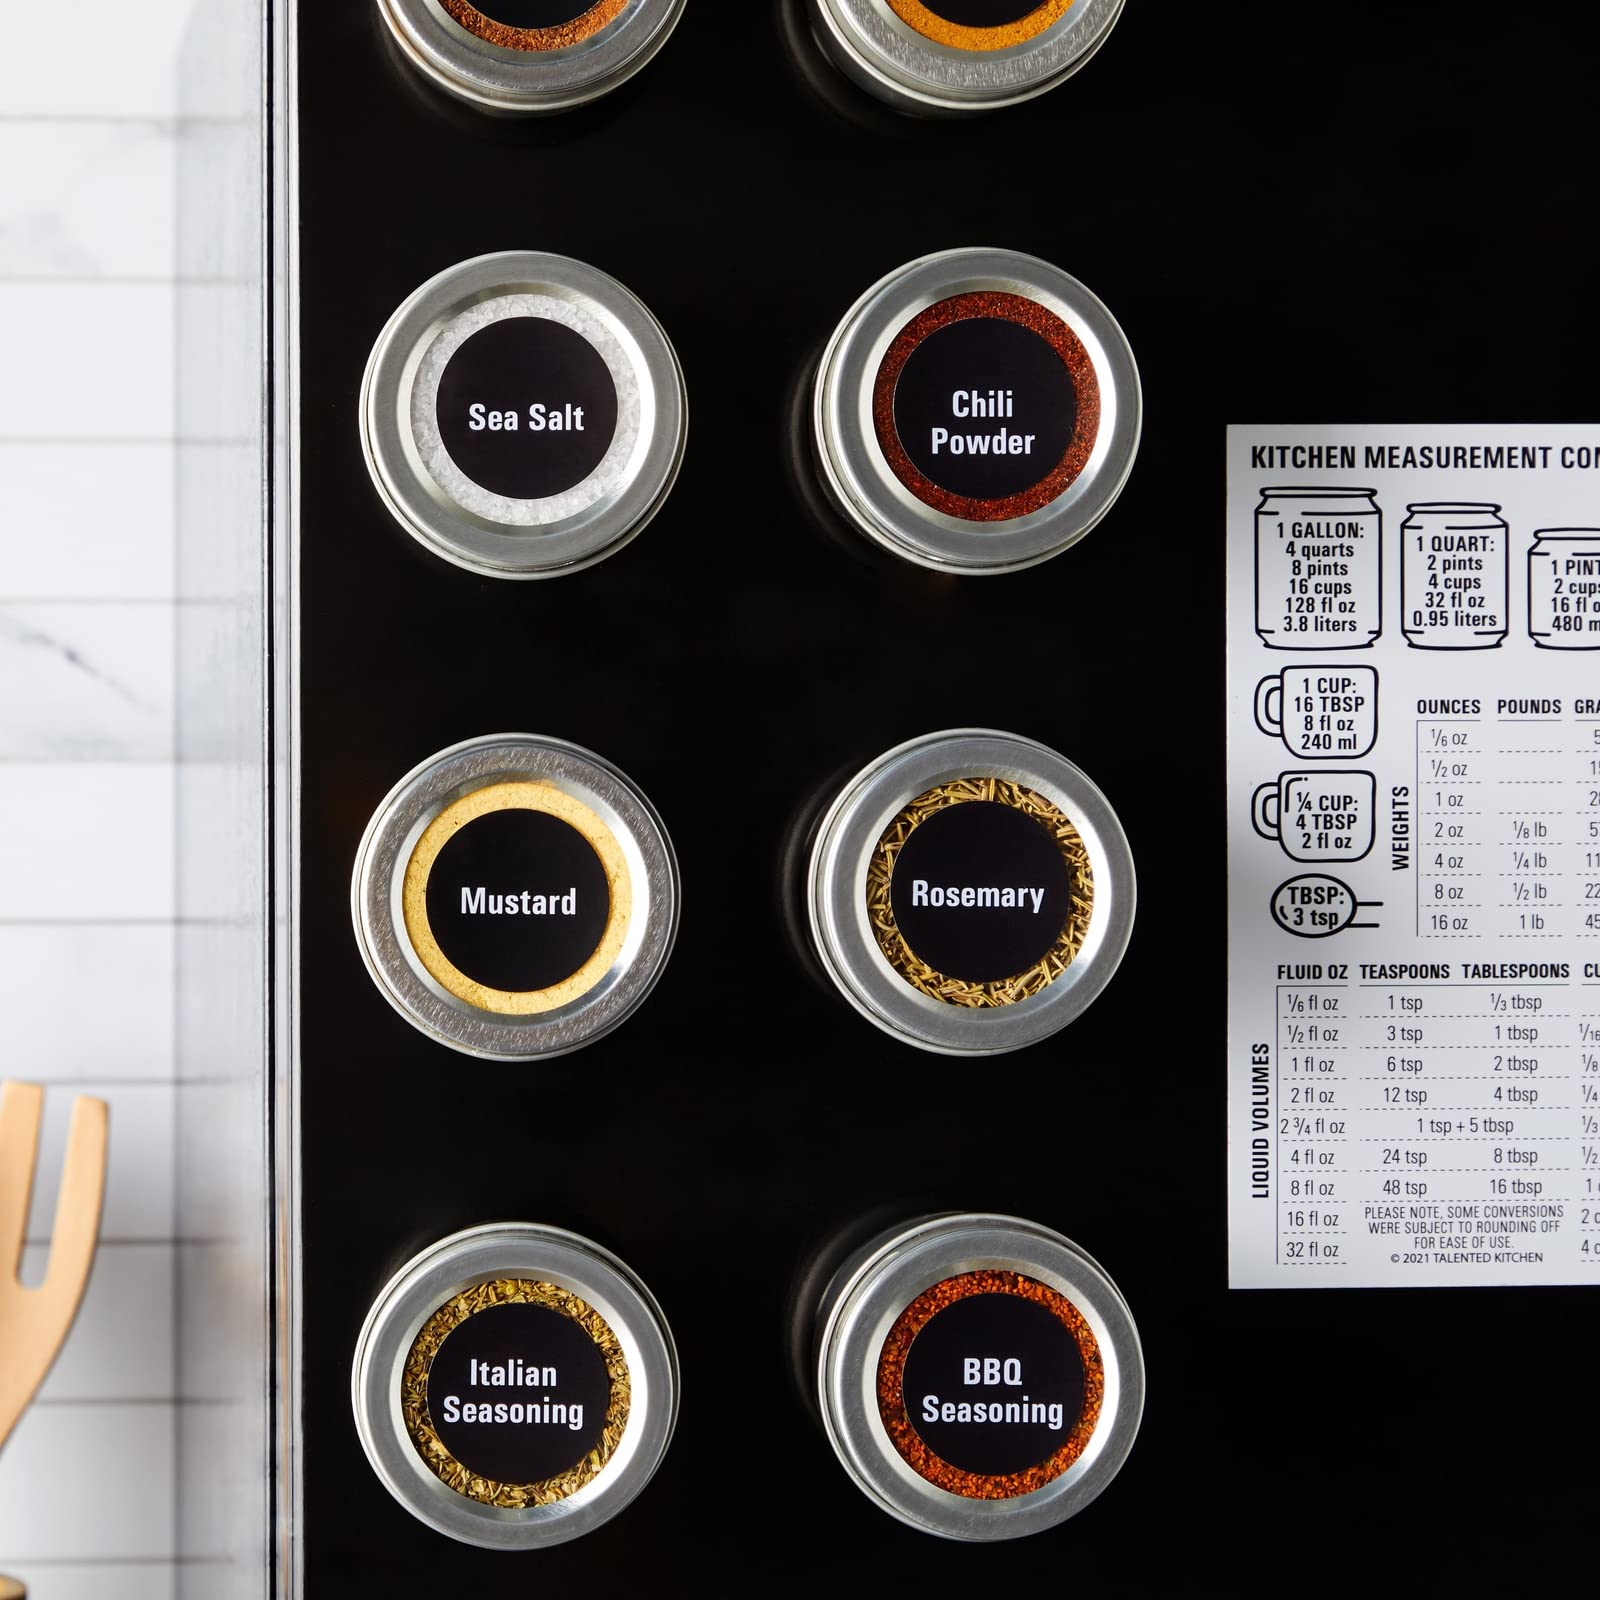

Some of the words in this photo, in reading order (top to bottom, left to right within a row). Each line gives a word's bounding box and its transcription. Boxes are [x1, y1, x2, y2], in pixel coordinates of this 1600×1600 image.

[952, 390, 1013, 418] Chili
[468, 403, 519, 431] Sea
[528, 403, 585, 431] Salt
[931, 427, 1036, 455] Powder
[1251, 445, 1356, 469] KITCHEN
[1364, 445, 1553, 469] MEASUREMENT
[1277, 522, 1284, 539] 1
[1291, 521, 1364, 539] GALLON:
[1285, 540, 1297, 557] 4
[1301, 542, 1354, 561] quarts
[1416, 535, 1423, 552] 1
[1431, 535, 1494, 552] QUART:
[1292, 559, 1302, 576] 8
[1307, 559, 1348, 580] pints
[1427, 554, 1437, 571] 2
[1442, 554, 1483, 575] pints
[1551, 559, 1558, 576] 1
[1289, 578, 1309, 595] 16
[1314, 582, 1352, 599] cups
[1428, 573, 1439, 589] 4
[1444, 577, 1482, 593] cups
[1554, 578, 1564, 594] 2
[1569, 582, 1600, 598] cup
[1285, 596, 1315, 614] 128
[1320, 596, 1333, 613] fl
[1338, 601, 1356, 614] oz
[1425, 591, 1445, 608] 32
[1450, 591, 1462, 608] fl
[1468, 596, 1485, 608] oz
[1551, 596, 1570, 613] 16
[1575, 596, 1587, 613] fl
[1283, 615, 1308, 632] 3.8
[1314, 615, 1357, 632] liters
[1413, 610, 1449, 627] 0.95
[1454, 610, 1497, 627] liters
[1552, 615, 1583, 632] 480
[1303, 677, 1309, 694] 1
[1317, 677, 1356, 694] CUP:
[1294, 696, 1313, 713] 16
[1319, 696, 1365, 713] TBSP
[1417, 699, 1481, 714] OUNCES
[1497, 699, 1562, 714] POUNDS
[1304, 714, 1314, 732] 8
[1319, 714, 1331, 731] fl
[1336, 719, 1354, 731] oz
[1301, 733, 1332, 750] 240
[1338, 733, 1357, 750] ml
[1318, 795, 1358, 812] CUP:
[1435, 791, 1441, 807] 1
[1448, 794, 1464, 807] oz
[1295, 813, 1307, 831] 4
[1311, 813, 1357, 831] TBSP
[1391, 786, 1409, 871] WEIGHTS
[1434, 821, 1444, 838] 2
[1448, 825, 1464, 838] oz
[1302, 832, 1312, 849] 2
[1316, 832, 1329, 849] fl
[1334, 836, 1352, 849] oz
[1434, 853, 1444, 868] 4
[1448, 856, 1464, 869] oz
[912, 879, 1045, 914] Rosemary
[1287, 885, 1345, 905] TBSP:
[1434, 883, 1444, 900] 8
[1448, 887, 1464, 900] oz
[1534, 883, 1547, 899] lb
[461, 886, 576, 915] Mustard
[1293, 907, 1304, 926] 3
[1309, 909, 1339, 930] tsp
[1431, 914, 1448, 930] 16
[1452, 918, 1468, 930] oz
[1519, 914, 1525, 930] 1
[1531, 913, 1545, 930] lb
[1277, 964, 1323, 980] FLUID
[1327, 964, 1349, 980] OZ
[1359, 963, 1450, 980] TEASPOONS
[1461, 963, 1570, 979] TABLESPOONS
[1308, 994, 1318, 1011] fl
[1322, 998, 1339, 1011] oz
[1388, 994, 1394, 1010] 1
[1400, 996, 1423, 1014] tsp
[1511, 993, 1542, 1013] tbsp
[1387, 1025, 1396, 1041] 3
[1400, 1027, 1423, 1045] tsp
[1495, 1025, 1501, 1041] 1
[1507, 1024, 1538, 1044] tbsp
[1292, 1056, 1298, 1073] 1
[1304, 1056, 1314, 1073] fl
[1318, 1060, 1335, 1073] oz
[1387, 1055, 1396, 1072] 6
[1400, 1057, 1423, 1076] tsp
[1493, 1055, 1503, 1071] 2
[1507, 1055, 1538, 1075] tbsp
[1251, 1043, 1270, 1132] VOLUMES
[1291, 1087, 1300, 1104] 2
[1304, 1087, 1314, 1103] fl
[1319, 1091, 1335, 1104] oz
[1383, 1086, 1401, 1103] 12
[1405, 1088, 1427, 1106] tsp
[1493, 1086, 1503, 1101] 4
[1506, 1085, 1538, 1105] tbsp
[1417, 1117, 1423, 1133] 1
[1429, 1119, 1452, 1137] tsp
[1470, 1117, 1479, 1133] 5
[1482, 1116, 1514, 1136] tbsp
[1290, 1149, 1300, 1165] 4
[1304, 1148, 1314, 1165] fl
[1319, 1152, 1335, 1165] oz
[1383, 1148, 1401, 1165] 24
[1405, 1150, 1428, 1168] tsp
[1493, 1147, 1503, 1164] 8
[1506, 1147, 1538, 1167] tbsp
[1251, 1138, 1269, 1199] LIQUID
[1290, 1180, 1300, 1196] 8
[1304, 1179, 1314, 1196] fl
[1319, 1183, 1335, 1196] oz
[1382, 1179, 1401, 1195] 48
[1404, 1181, 1427, 1199] tsp
[1490, 1178, 1507, 1195] 16
[1511, 1178, 1543, 1198] tbsp
[1287, 1210, 1304, 1227] 16
[1308, 1210, 1318, 1226] fl
[1323, 1214, 1339, 1227] oz
[1364, 1206, 1406, 1220] PLEASE
[1410, 1206, 1443, 1220] NOTE,
[1447, 1205, 1480, 1219] SOME
[1483, 1204, 1564, 1219] CONVERSIONS
[1368, 1221, 1401, 1235] WERE
[1404, 1221, 1454, 1234] SUBJECT
[1457, 1220, 1473, 1234] TO
[1476, 1220, 1537, 1234] ROUNDING
[1540, 1220, 1561, 1233] OFF
[1286, 1241, 1304, 1258] 32
[1308, 1241, 1318, 1257] fl
[1323, 1245, 1339, 1258] oz
[1414, 1236, 1436, 1250] FOR
[1439, 1236, 1468, 1249] EASE
[1471, 1235, 1485, 1249] OF
[1489, 1235, 1514, 1249] USE.
[1402, 1253, 1429, 1264] 2021
[1432, 1252, 1492, 1264] TALENTED
[1494, 1252, 1543, 1263] KITCHEN
[470, 1358, 557, 1387] Italian
[963, 1357, 1023, 1386] BBQ
[443, 1395, 584, 1431] Seasoning
[922, 1394, 1063, 1430] Seasoning
